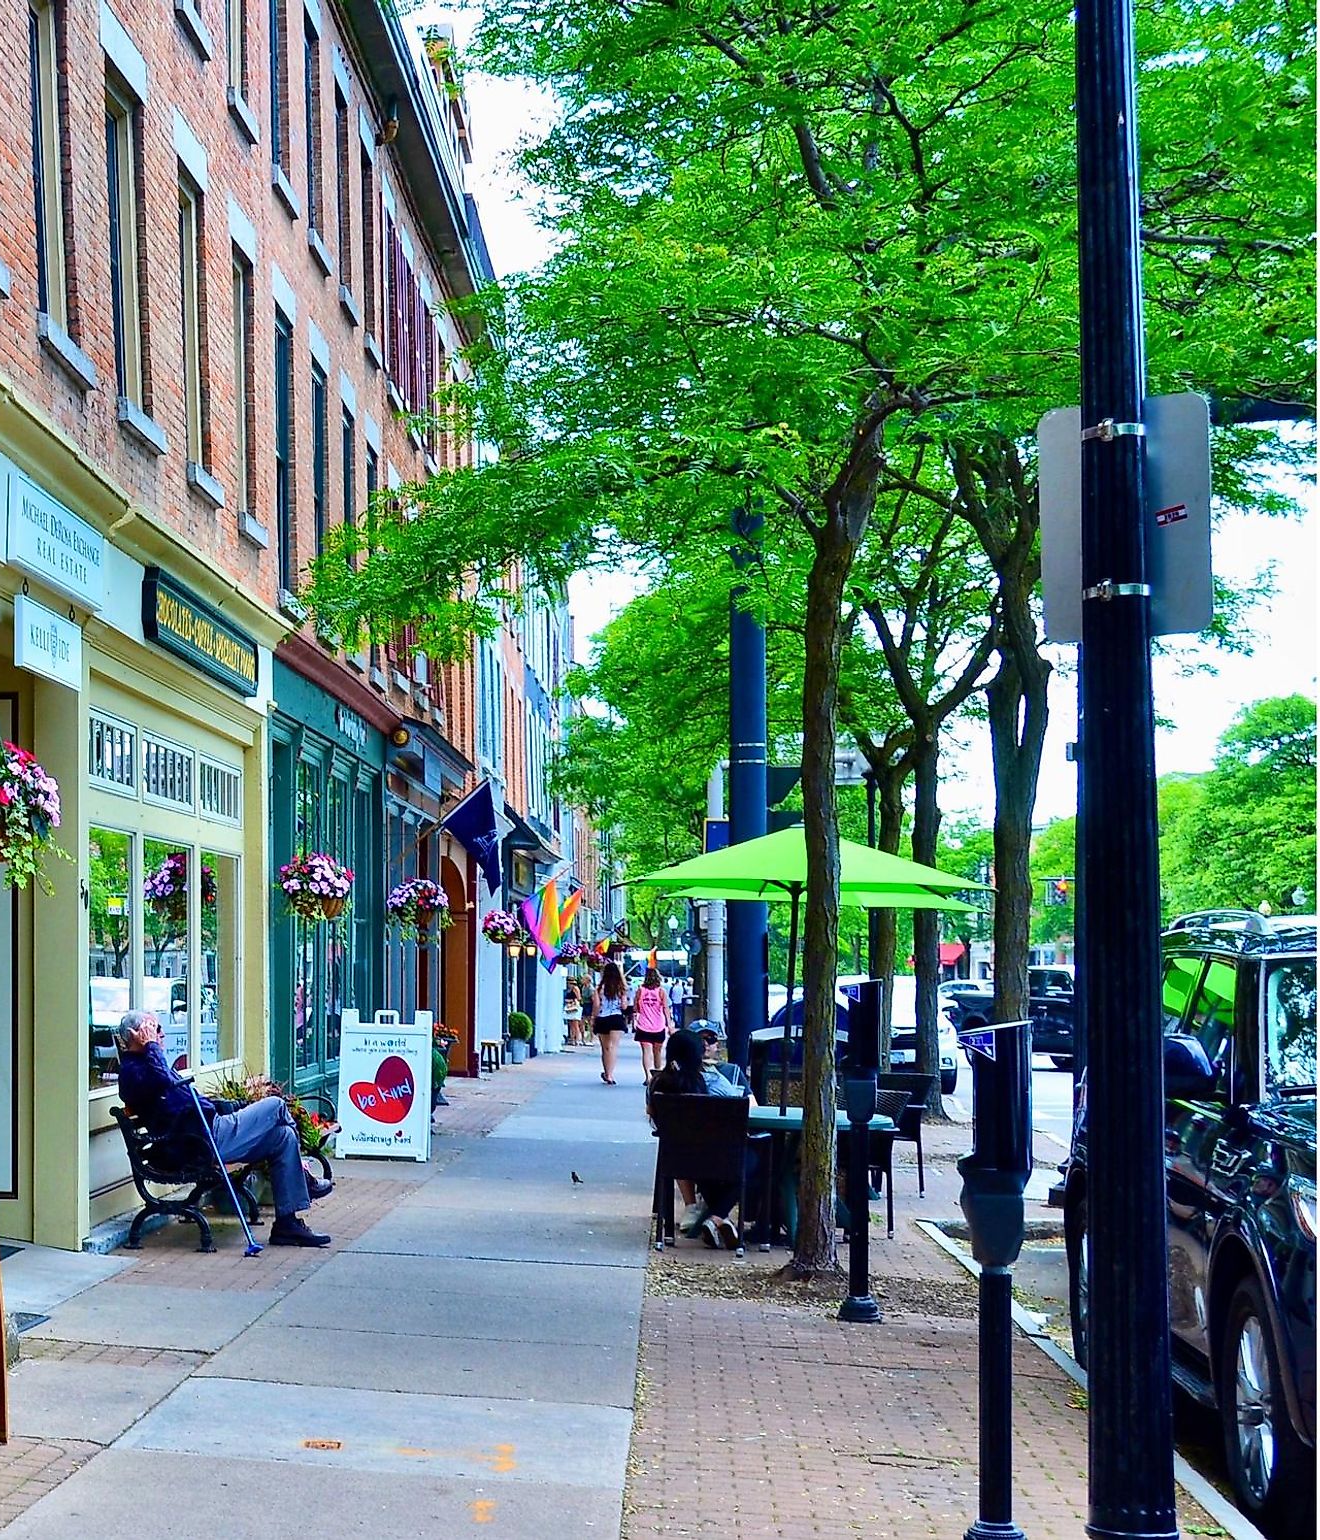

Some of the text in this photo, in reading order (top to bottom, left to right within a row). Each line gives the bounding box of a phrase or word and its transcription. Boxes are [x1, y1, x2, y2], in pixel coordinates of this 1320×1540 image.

[37, 537, 87, 585] REAL ESTATE
[356, 1078, 412, 1110] be kind
